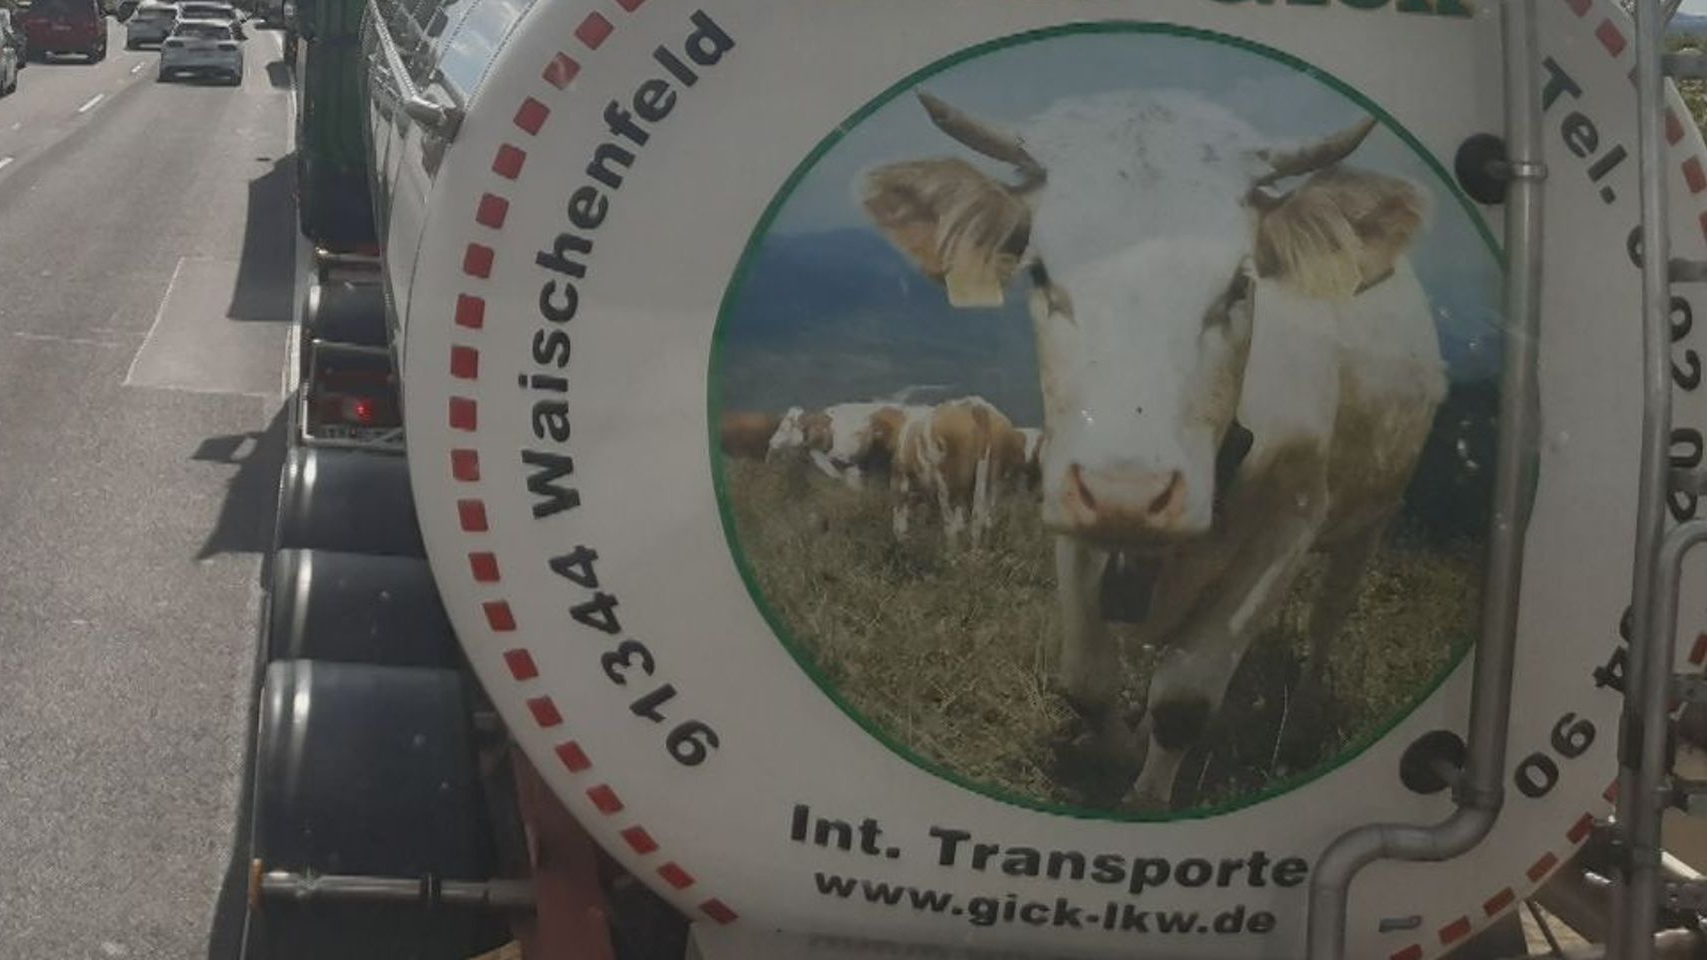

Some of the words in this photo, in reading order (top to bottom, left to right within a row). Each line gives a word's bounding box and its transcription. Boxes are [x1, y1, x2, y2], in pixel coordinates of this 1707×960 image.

[1542, 55, 1628, 205] Tel.
[517, 8, 737, 521] Waischenfeld
[548, 543, 721, 768] 91344
[790, 803, 901, 860] Int.
[929, 825, 1309, 894] Transporte
[814, 870, 1276, 934] www.gick-lkw.de
